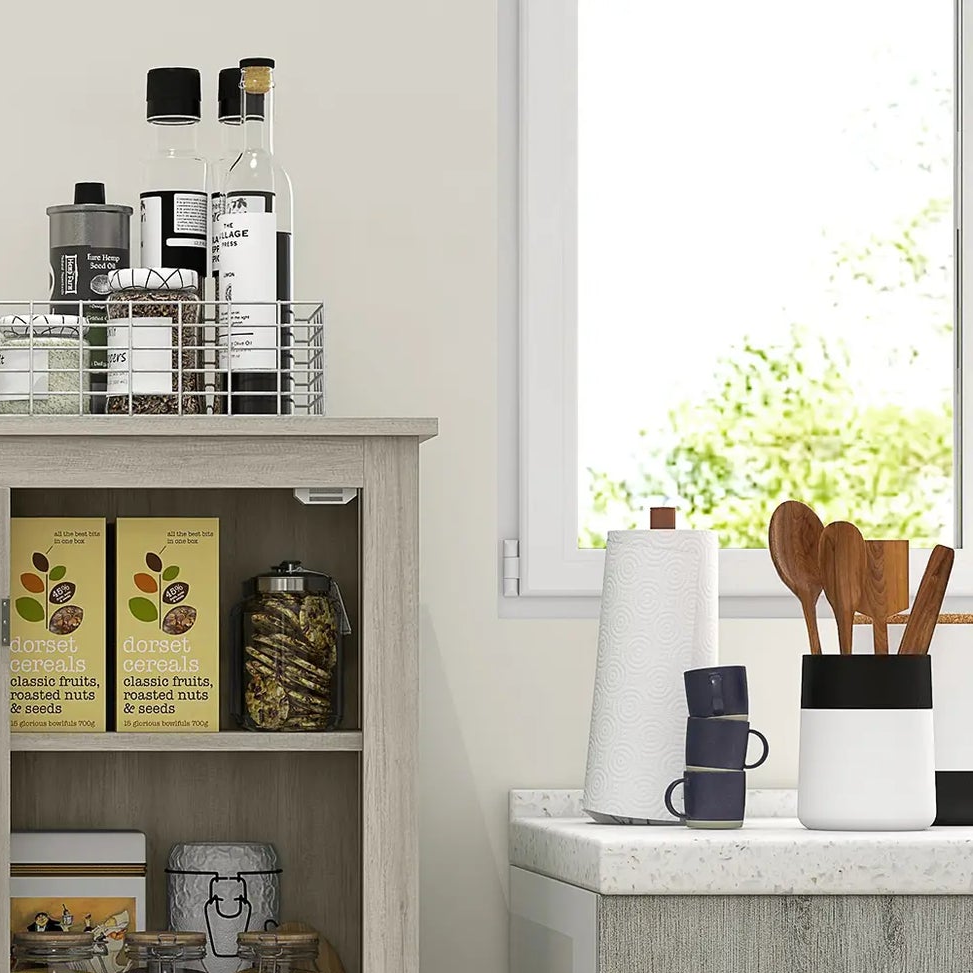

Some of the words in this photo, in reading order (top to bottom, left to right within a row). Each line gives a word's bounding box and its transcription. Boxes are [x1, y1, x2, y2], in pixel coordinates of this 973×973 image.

[102, 254, 121, 263] Hemp
[90, 262, 106, 270] Seed
[10, 636, 78, 653] dorset
[123, 636, 191, 653] dorset
[10, 656, 86, 673] cereals
[123, 656, 199, 673] cereals
[10, 676, 56, 687] classic
[59, 676, 100, 688] fruits,
[123, 676, 169, 687] classic
[172, 676, 213, 688] fruits,
[10, 690, 60, 700] roasted
[64, 690, 95, 700] nuts
[123, 690, 174, 700] roasted
[178, 690, 209, 700] nuts
[10, 703, 22, 714] &
[25, 703, 62, 714] seeds
[123, 703, 135, 714] &
[138, 703, 176, 714] seeds
[19, 720, 47, 728] glorious
[78, 720, 96, 728] 700g
[132, 720, 160, 728] glorious
[191, 720, 209, 728] 700g
